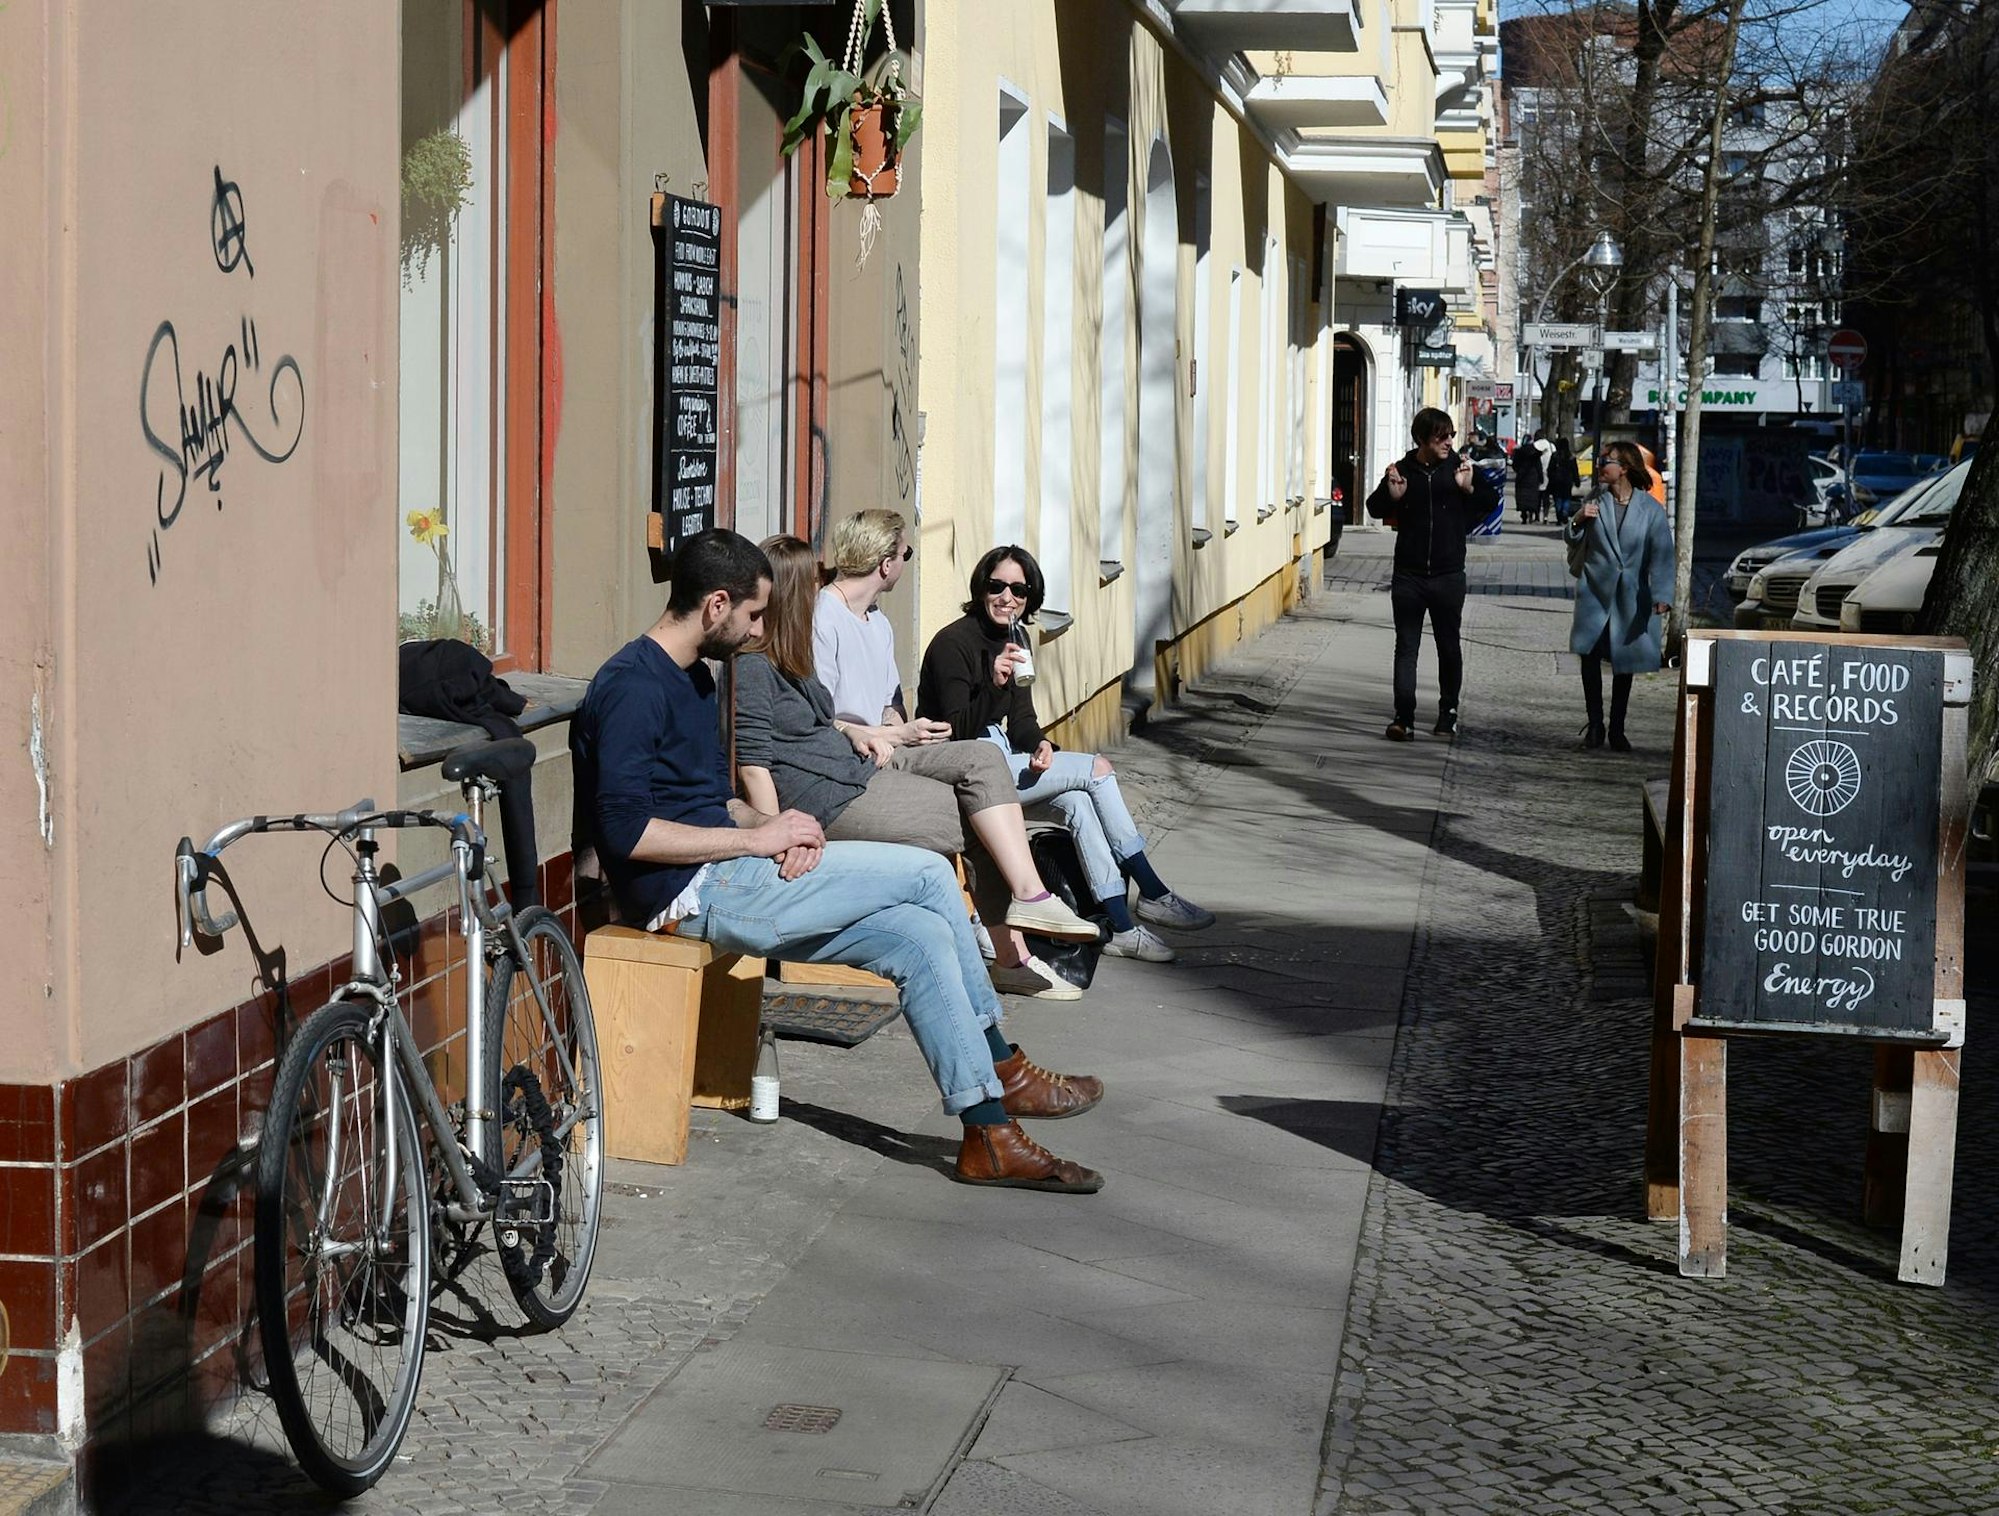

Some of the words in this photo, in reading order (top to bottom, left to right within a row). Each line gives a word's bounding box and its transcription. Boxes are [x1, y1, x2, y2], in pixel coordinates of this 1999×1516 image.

[1407, 297, 1435, 318] sky
[1539, 328, 1578, 340] Weisestr.
[1678, 389, 1757, 405] CMPANY
[673, 488, 690, 511] HOUSE
[693, 484, 713, 507] TECHNO
[1842, 661, 1910, 693] FOOD
[1741, 692, 1761, 716] &
[1773, 694, 1898, 726] RECORDS
[1767, 825, 1835, 852] open
[1785, 844, 1913, 882] everyday
[1742, 901, 1781, 923] GET
[1788, 904, 1845, 929] SOME
[1855, 909, 1907, 933] TRUE
[1754, 929, 1816, 954] GOOD
[1820, 934, 1902, 960] GORDON
[1763, 963, 1875, 1010] Energy
